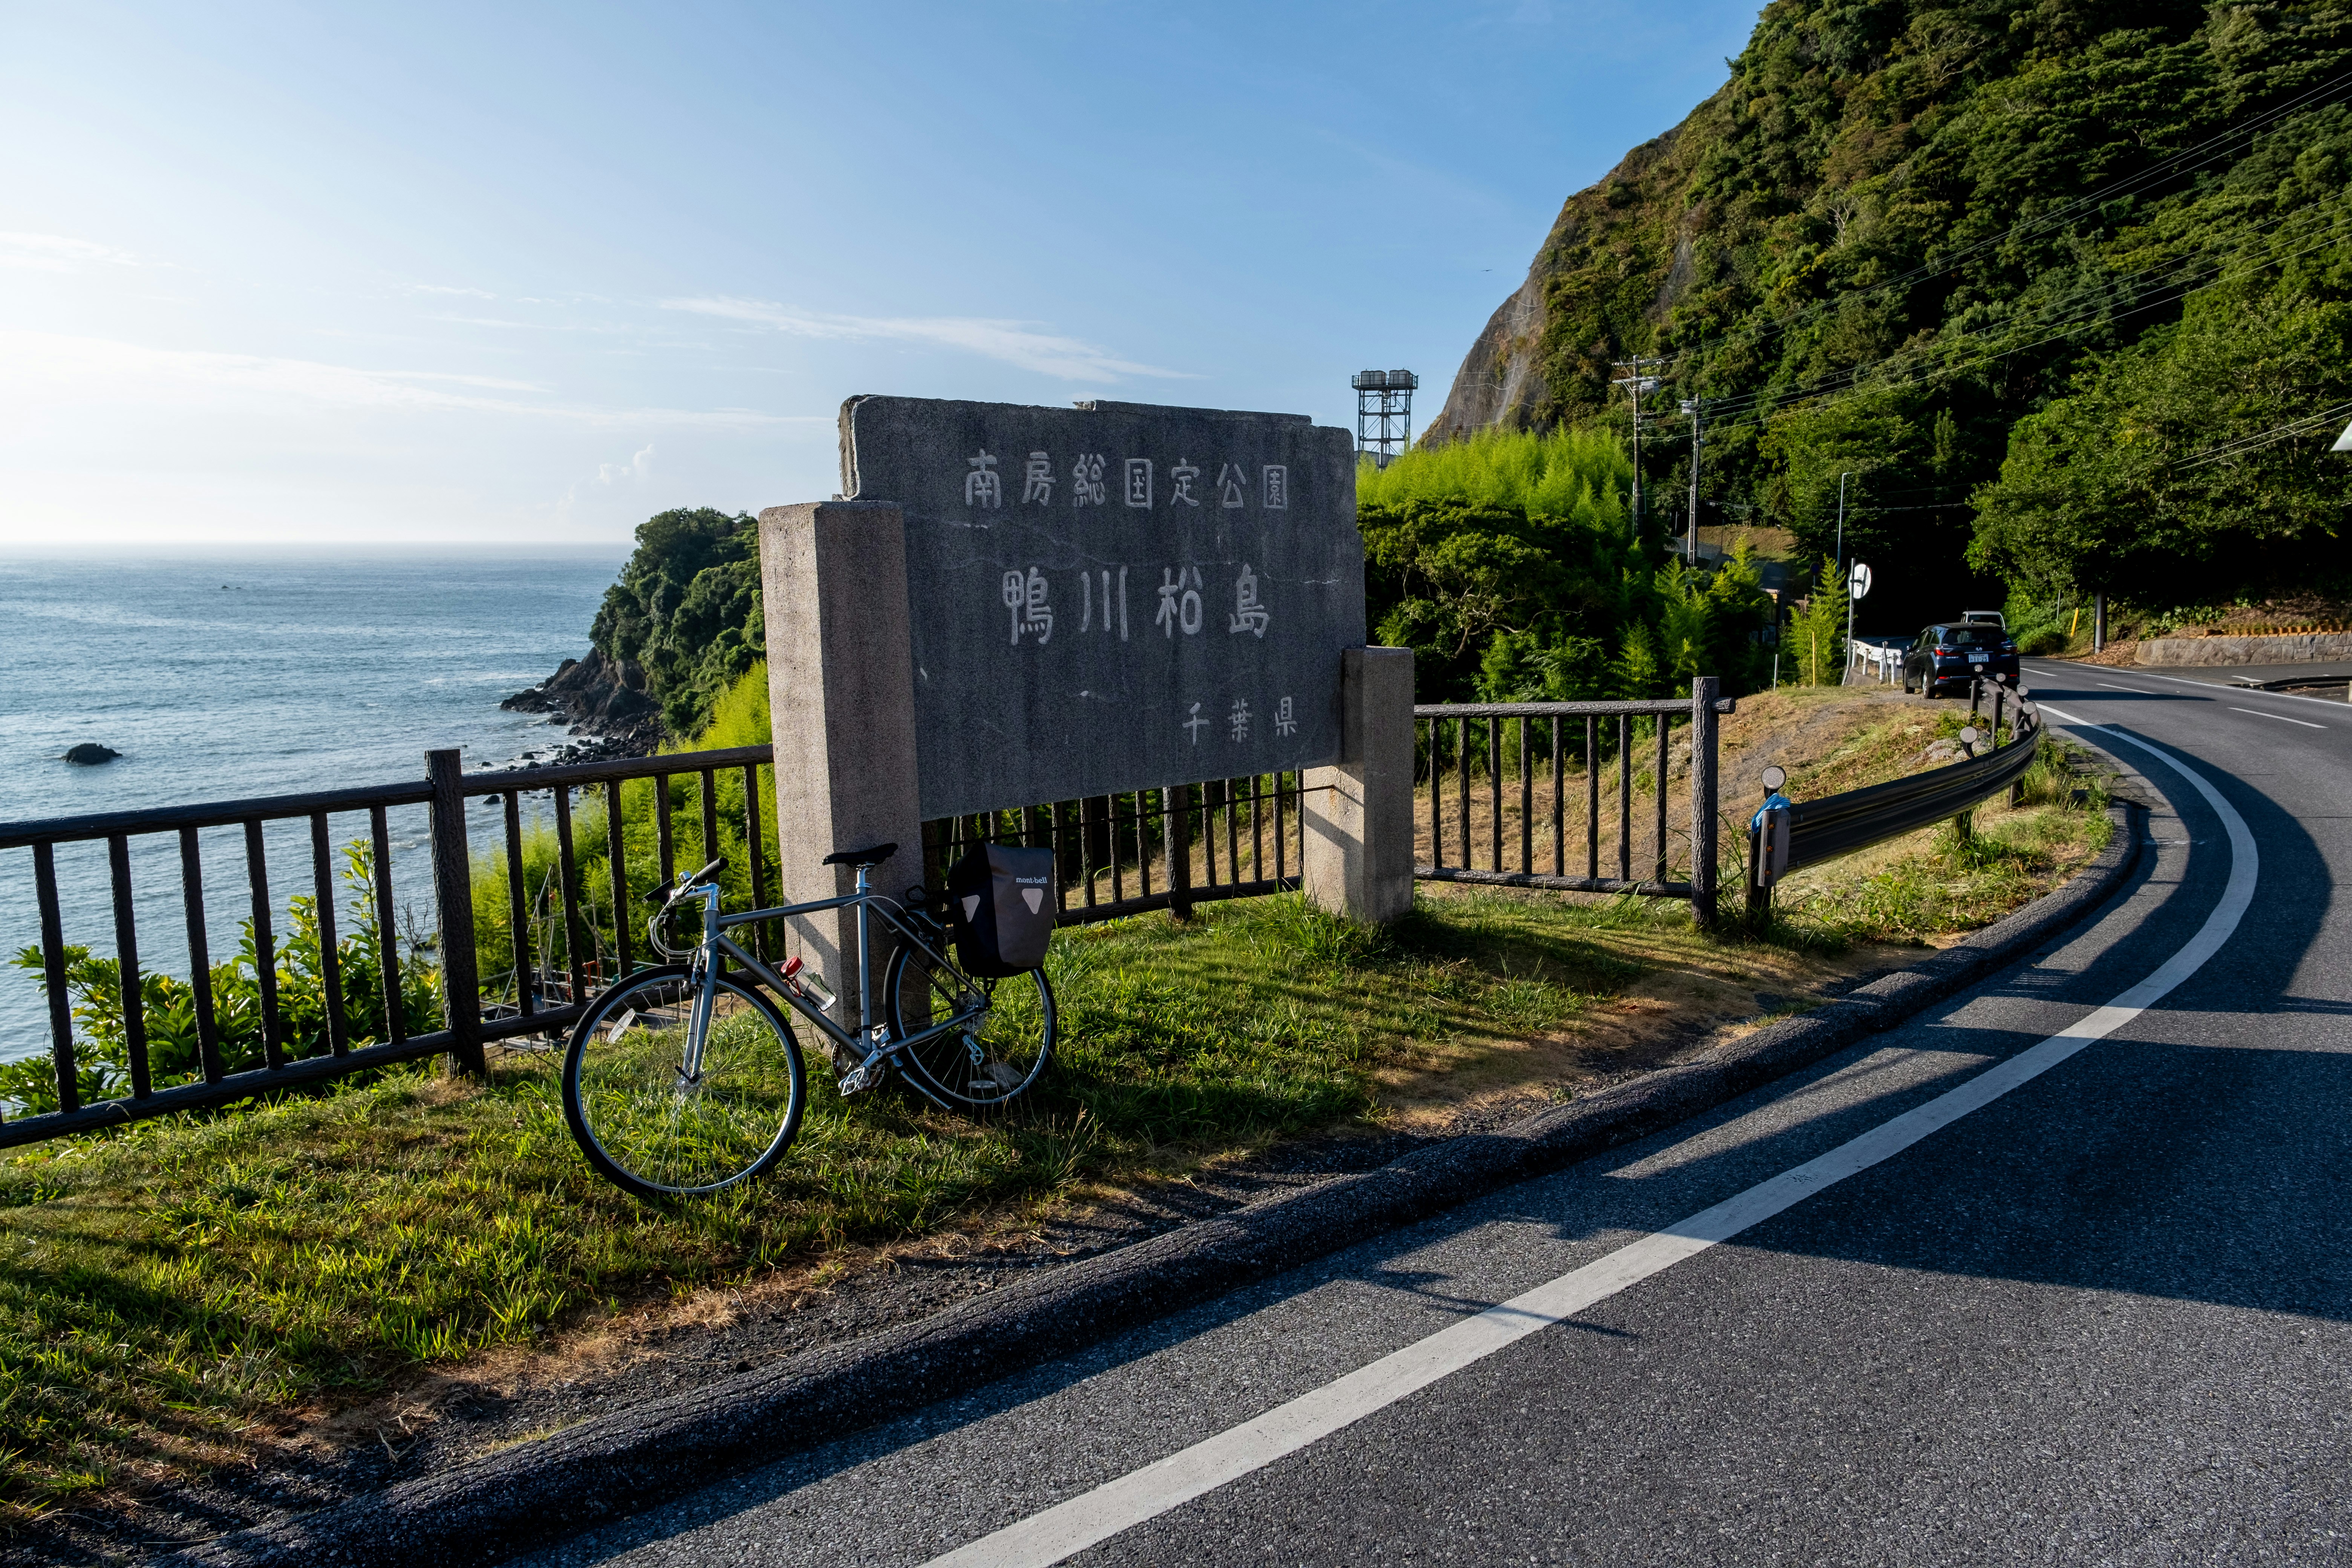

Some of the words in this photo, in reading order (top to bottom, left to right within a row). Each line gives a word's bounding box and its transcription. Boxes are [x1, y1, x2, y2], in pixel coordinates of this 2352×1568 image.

[965, 449, 1288, 509] 南房総国定公園
[1182, 697, 1297, 746] 千葉県
